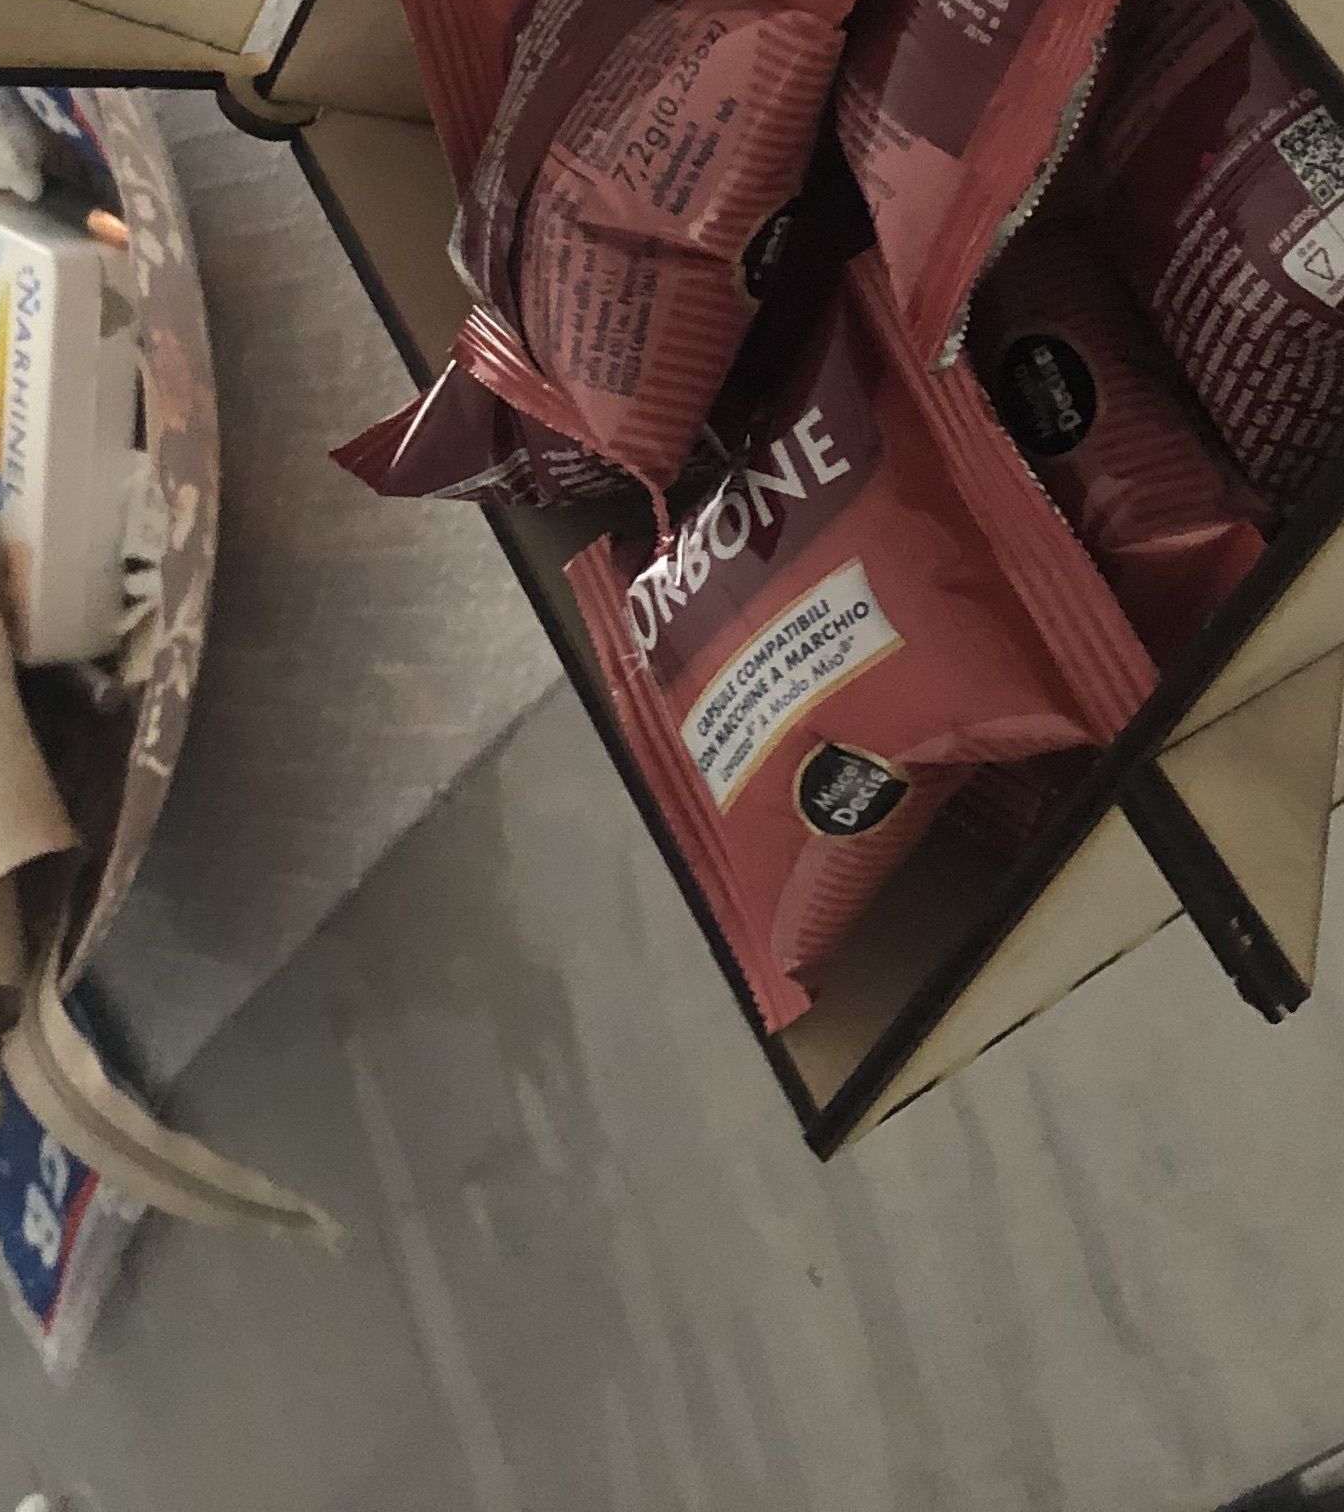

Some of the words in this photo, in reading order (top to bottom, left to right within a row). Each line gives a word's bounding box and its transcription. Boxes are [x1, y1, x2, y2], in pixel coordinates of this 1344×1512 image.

[5, 281, 38, 498] NARHINEL
[736, 597, 832, 684] COMPATIBILI
[783, 599, 871, 671] MARCHIO
[814, 752, 863, 812] Miscel
[832, 768, 890, 828] Decis
